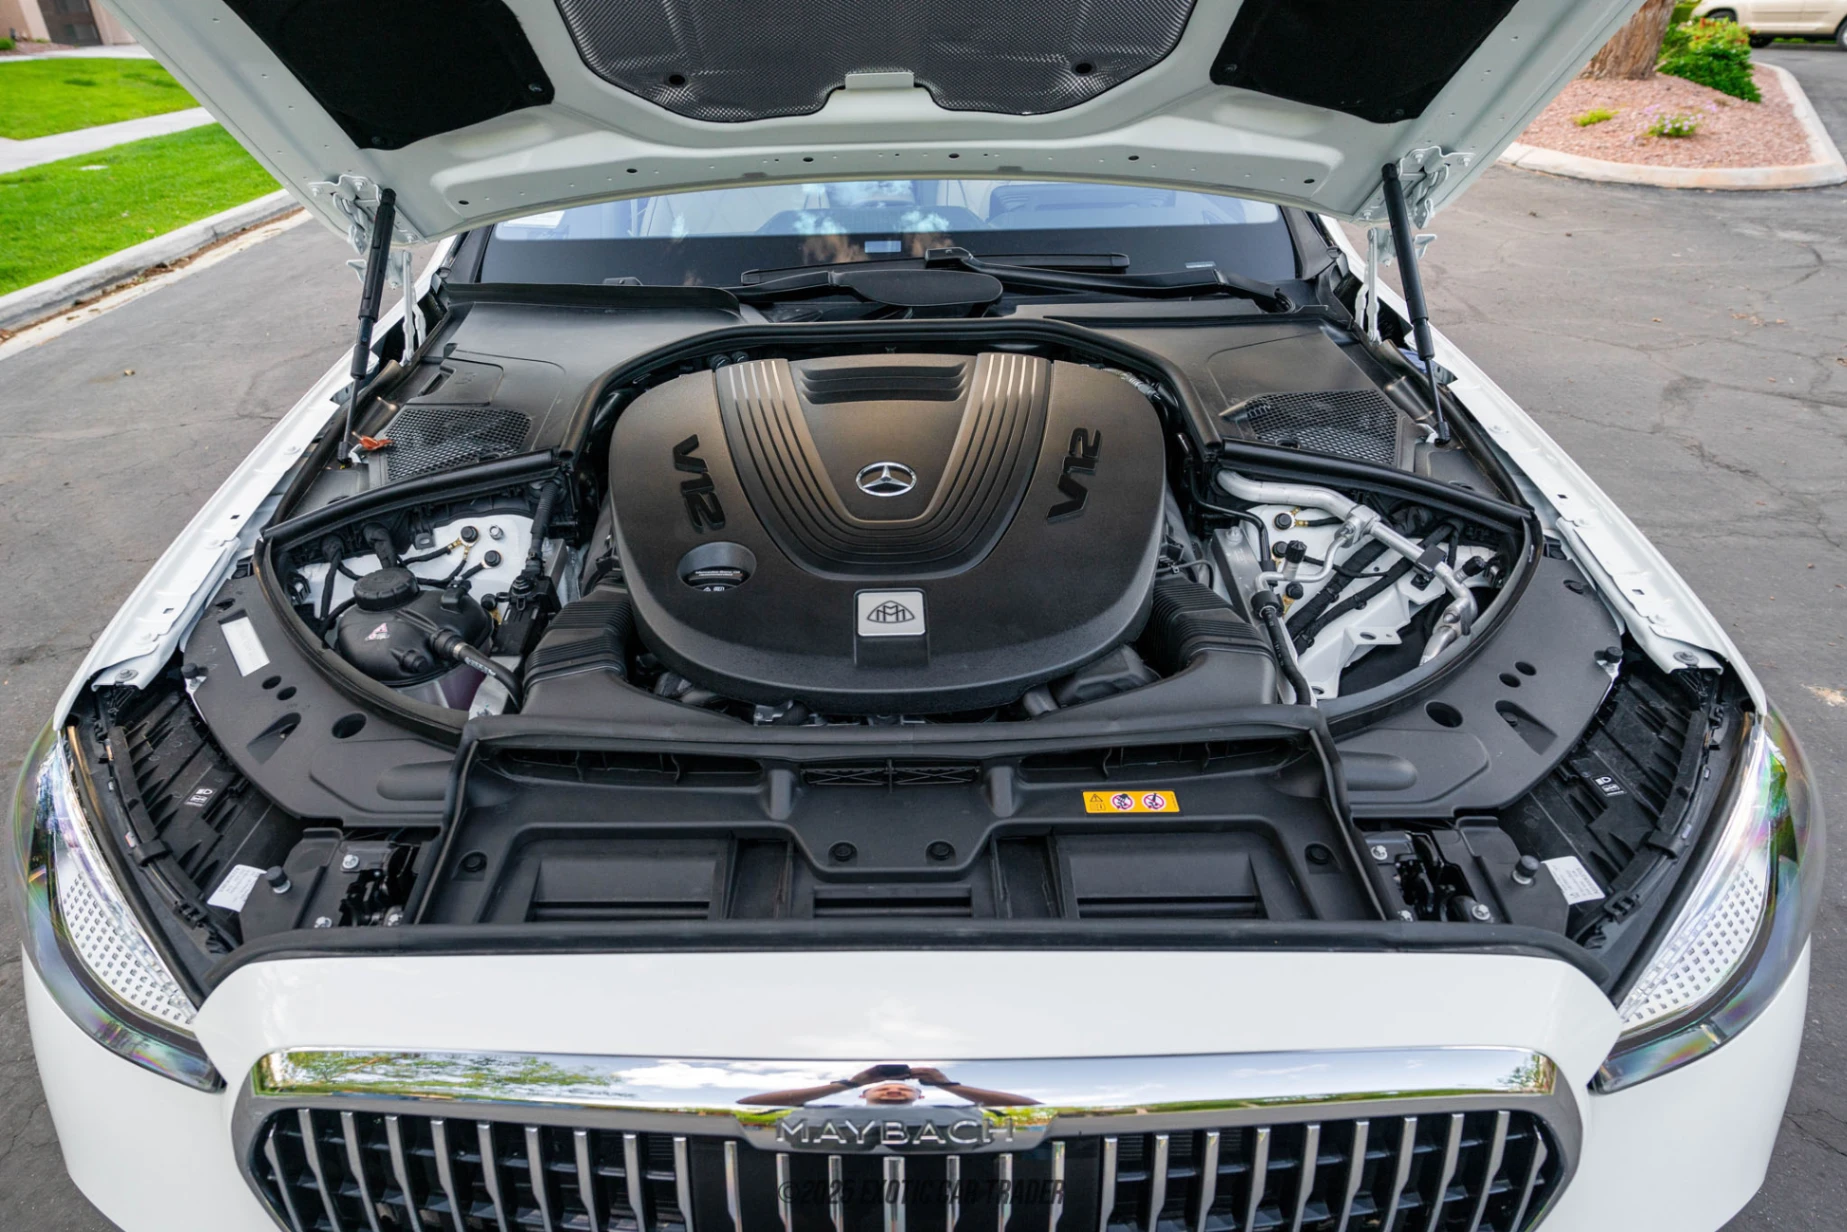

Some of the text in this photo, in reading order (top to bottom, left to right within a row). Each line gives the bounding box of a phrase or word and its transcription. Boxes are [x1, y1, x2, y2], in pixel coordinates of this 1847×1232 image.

[673, 433, 726, 532] V12
[1046, 427, 1101, 522] V12
[776, 1118, 1014, 1145] MAYBACH
